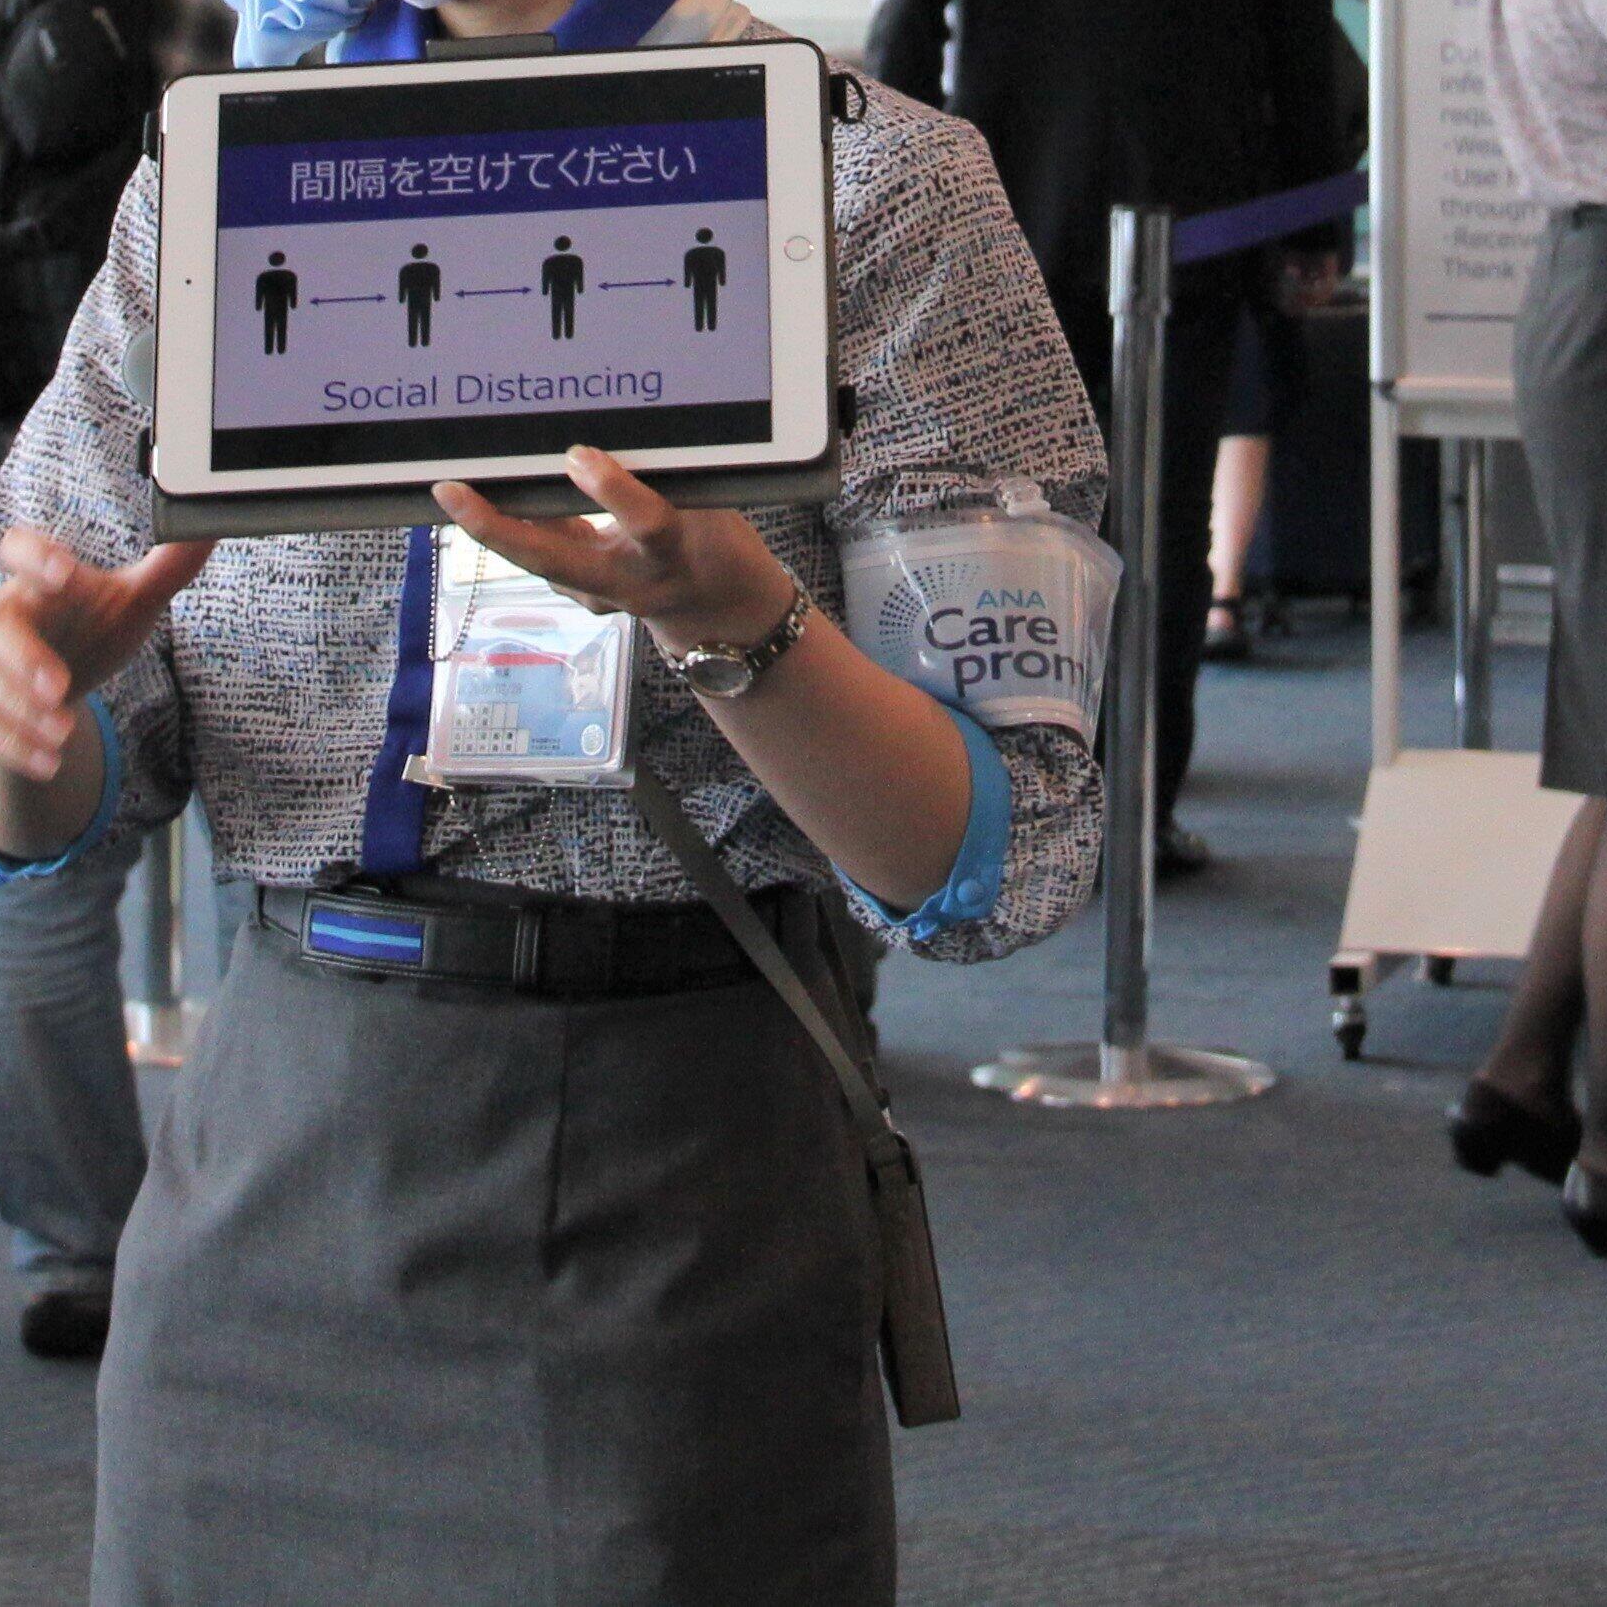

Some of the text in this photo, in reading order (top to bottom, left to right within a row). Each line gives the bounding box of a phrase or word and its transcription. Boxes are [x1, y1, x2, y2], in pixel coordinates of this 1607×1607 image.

[290, 141, 698, 205] 間隔を空けてください
[322, 365, 666, 414] Social Distancing
[976, 588, 1046, 609] ANA
[924, 607, 1059, 651] Care
